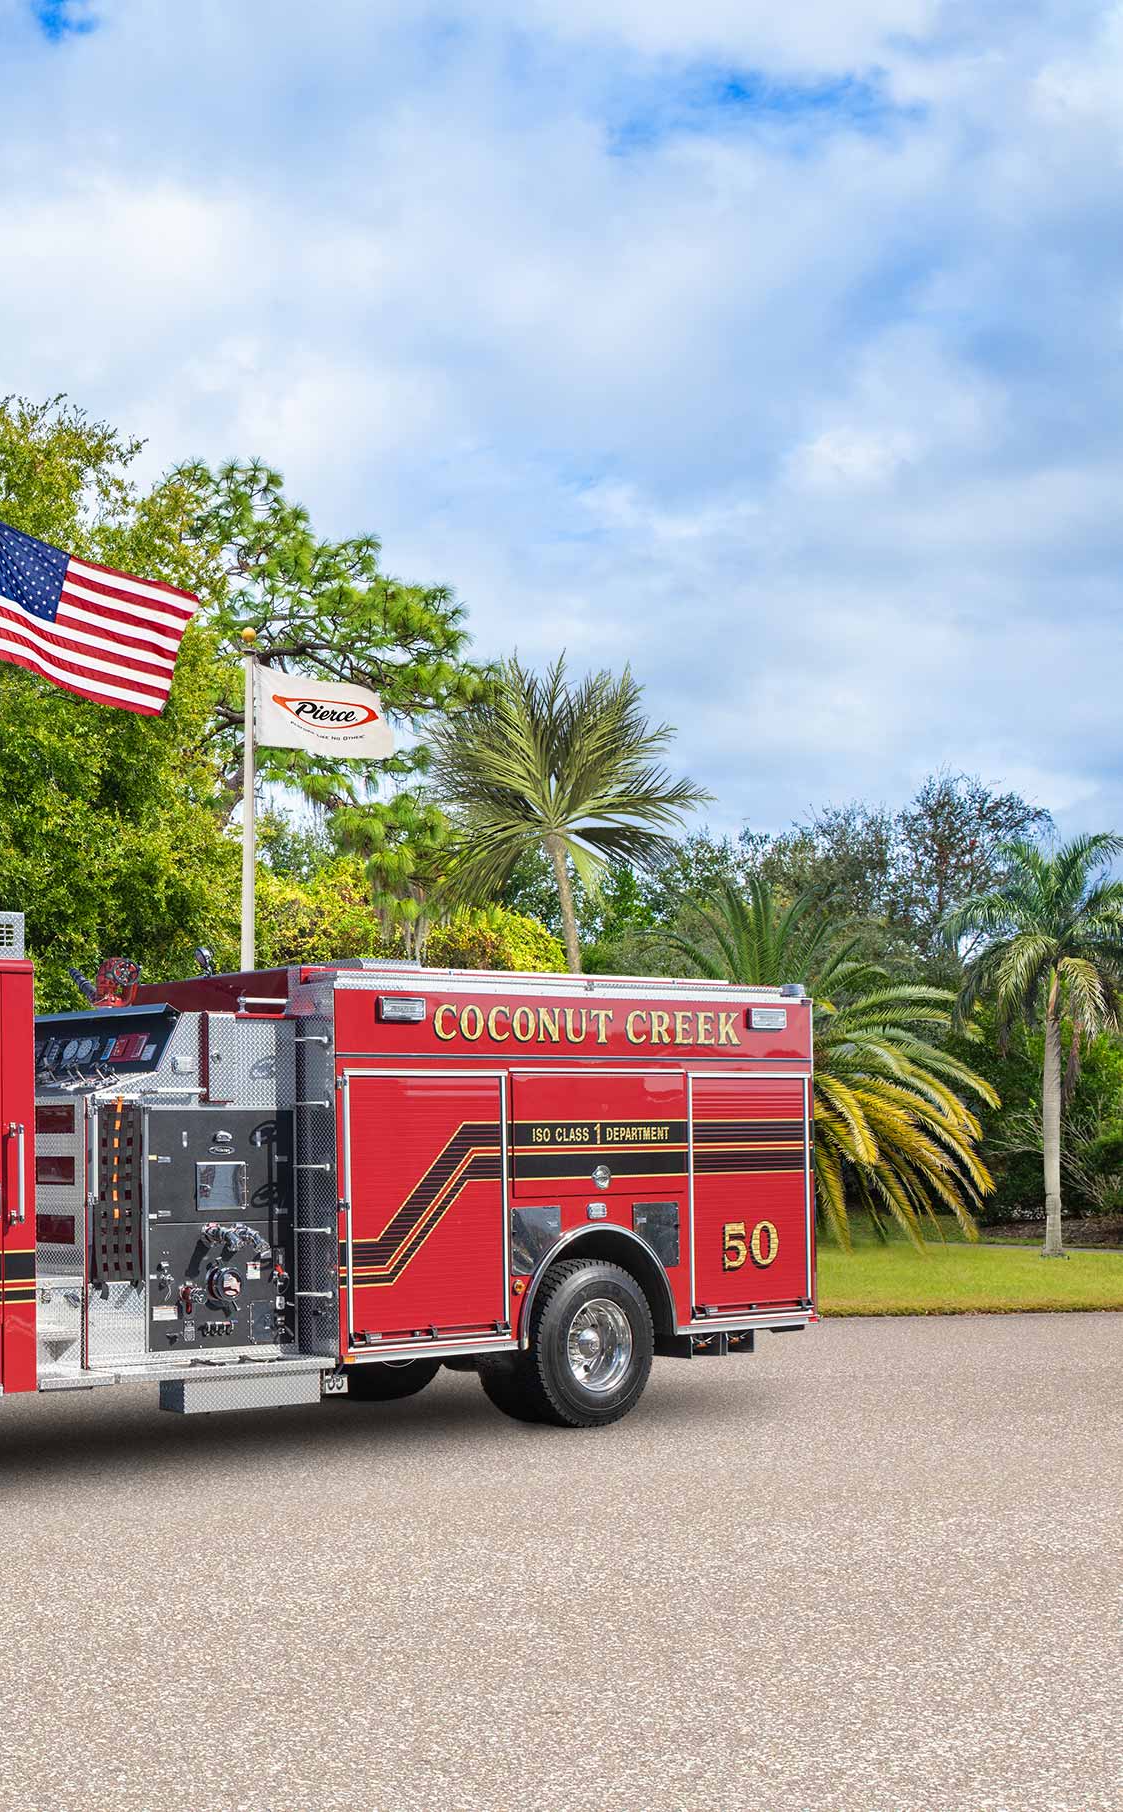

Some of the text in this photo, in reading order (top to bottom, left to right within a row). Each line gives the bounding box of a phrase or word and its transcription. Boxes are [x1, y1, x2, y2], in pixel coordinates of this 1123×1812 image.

[295, 701, 357, 722] Pierce
[433, 1003, 742, 1047] COCONUT CREEK
[532, 1123, 670, 1145] ISO CLASS 1 DEPARTMENT
[722, 1220, 780, 1272] 50
